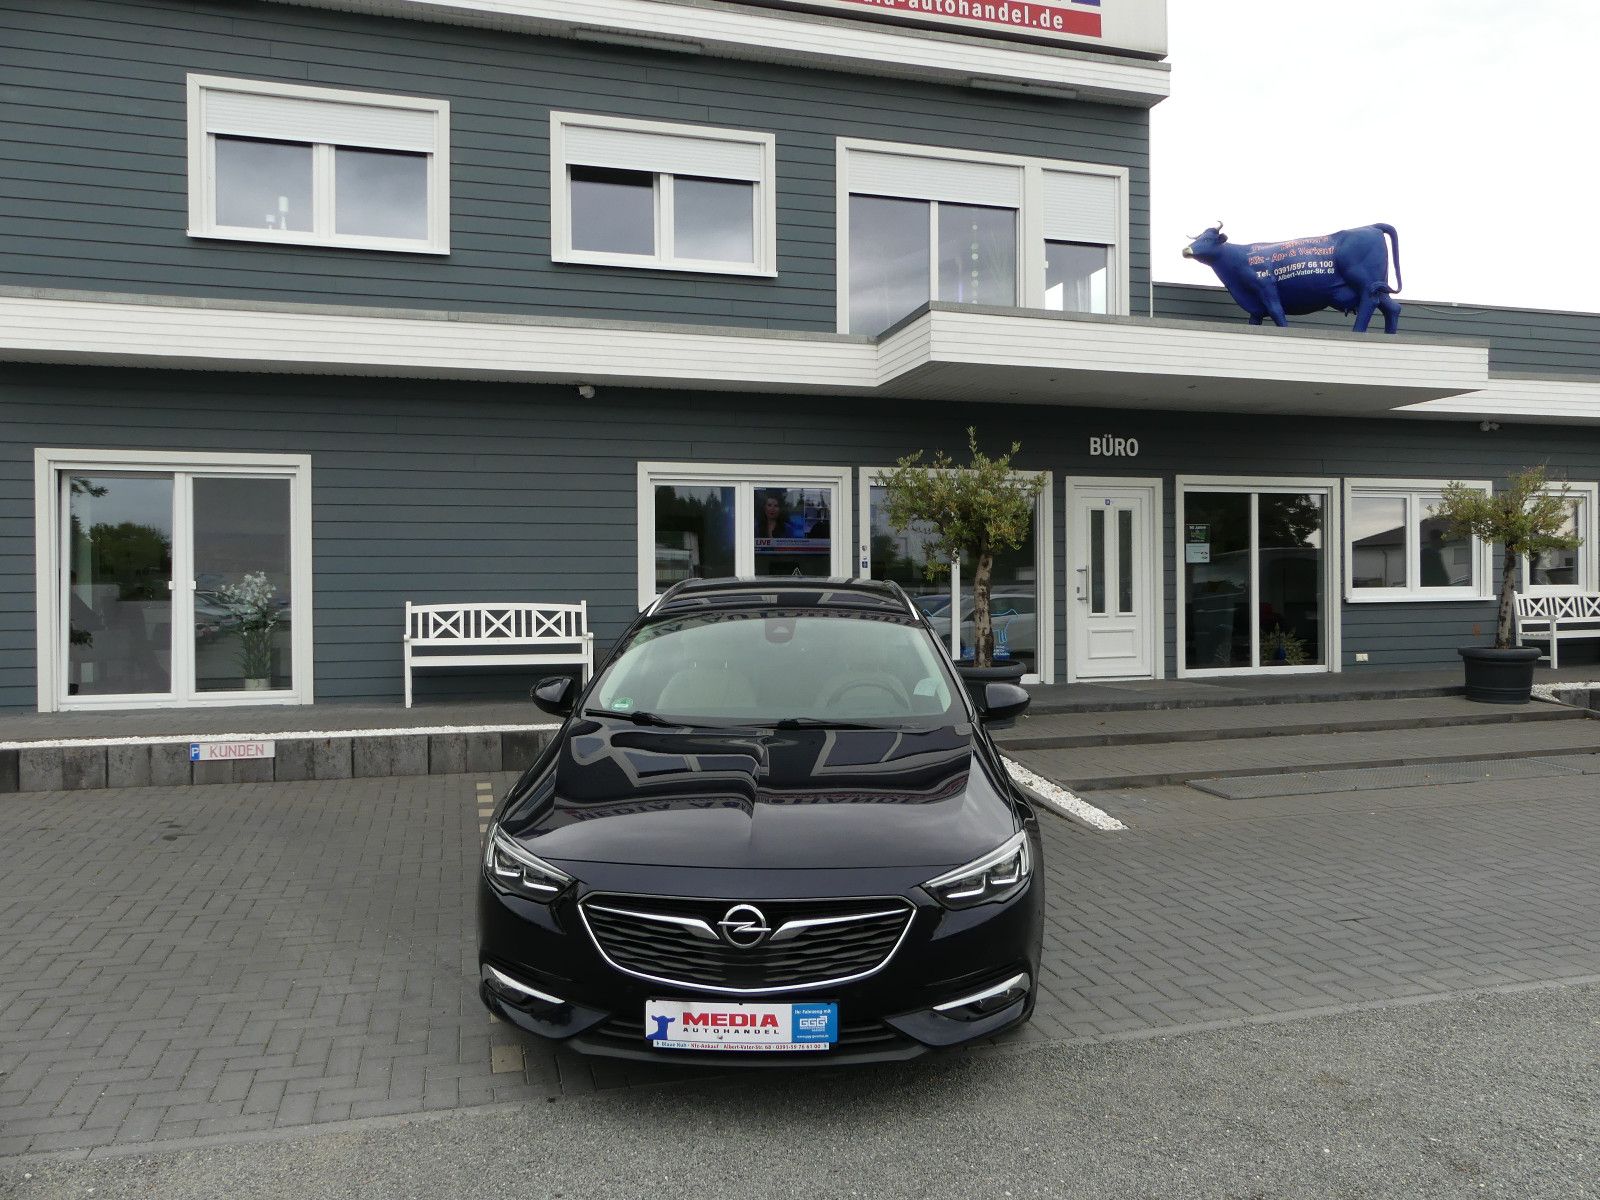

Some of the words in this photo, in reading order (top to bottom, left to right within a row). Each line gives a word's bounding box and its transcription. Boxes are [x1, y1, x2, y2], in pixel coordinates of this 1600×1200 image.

[1256, 269, 1271, 278] Tel.
[1273, 261, 1306, 276] 0391/597
[1319, 260, 1334, 268] 100
[1090, 434, 1139, 457] BÜRO
[191, 747, 200, 757] P
[209, 744, 265, 758] KUNDEN
[682, 1012, 779, 1027] MEDIA
[682, 1027, 779, 1035] AUTOHANDEL
